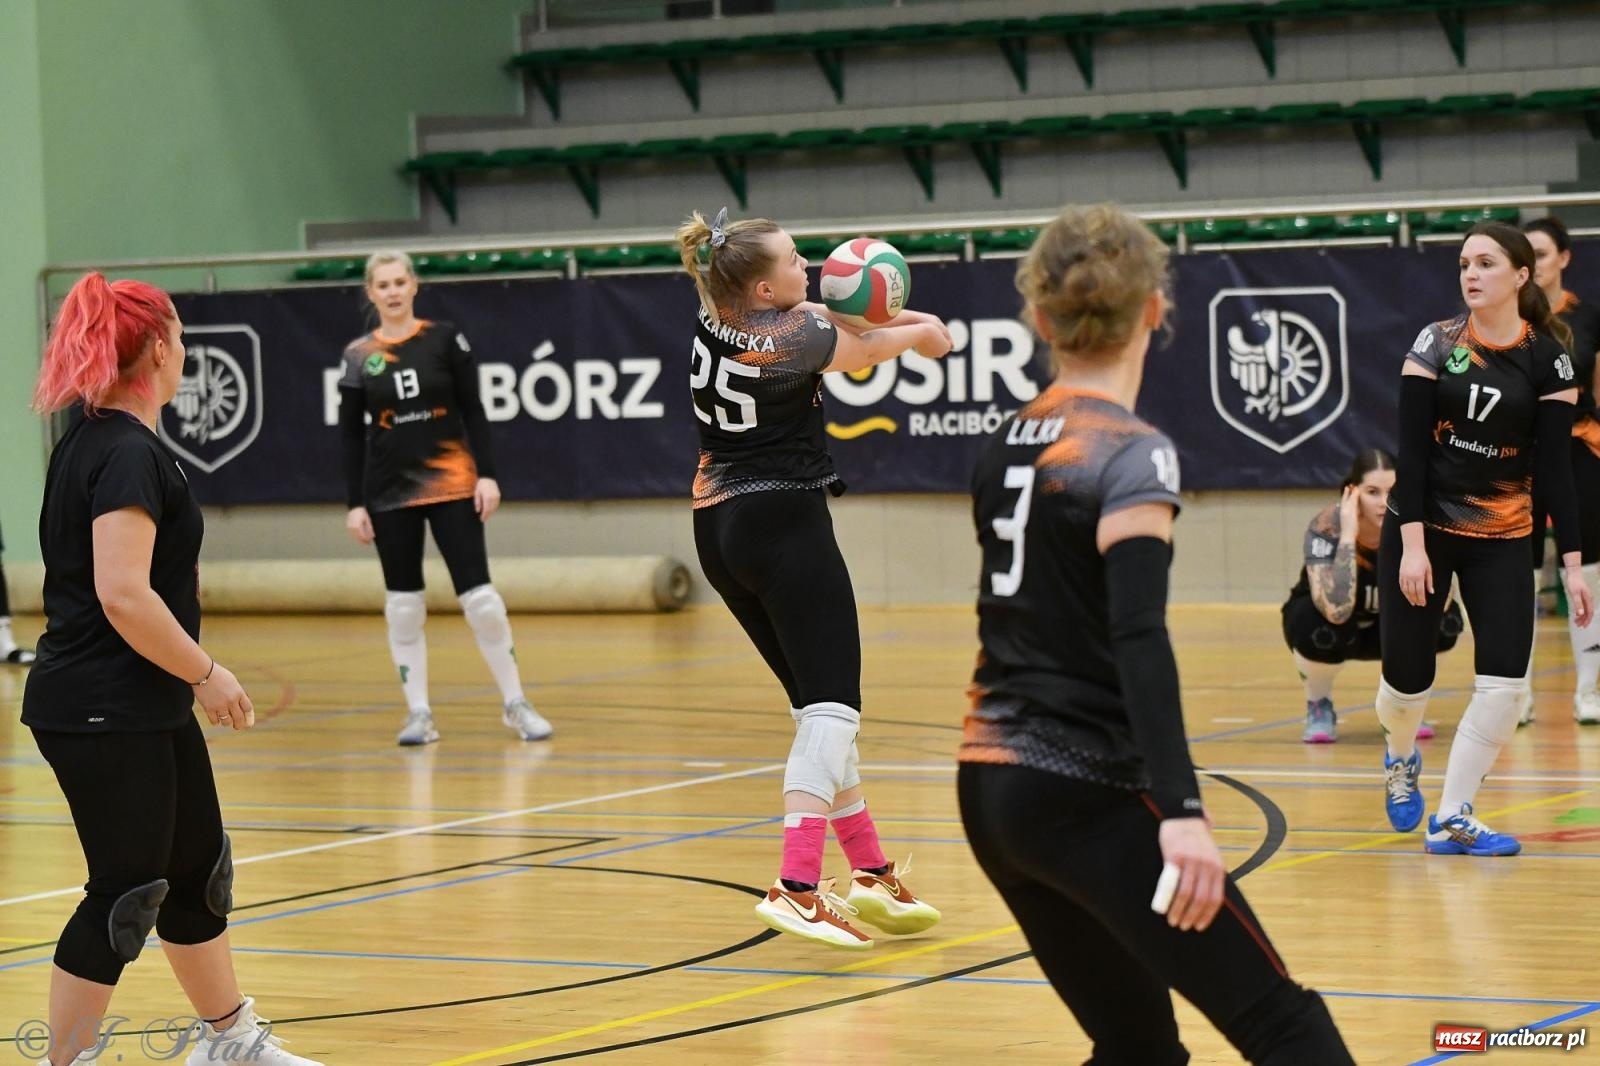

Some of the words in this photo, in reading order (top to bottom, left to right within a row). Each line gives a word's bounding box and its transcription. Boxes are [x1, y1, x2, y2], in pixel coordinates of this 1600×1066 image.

[393, 368, 420, 400] 13
[690, 336, 761, 433] 25
[909, 403, 1019, 436] RACIBÓ
[1467, 383, 1502, 422] 17
[1449, 434, 1498, 458] Fundacja
[1499, 446, 1520, 459] JSW
[991, 465, 1036, 597] 3
